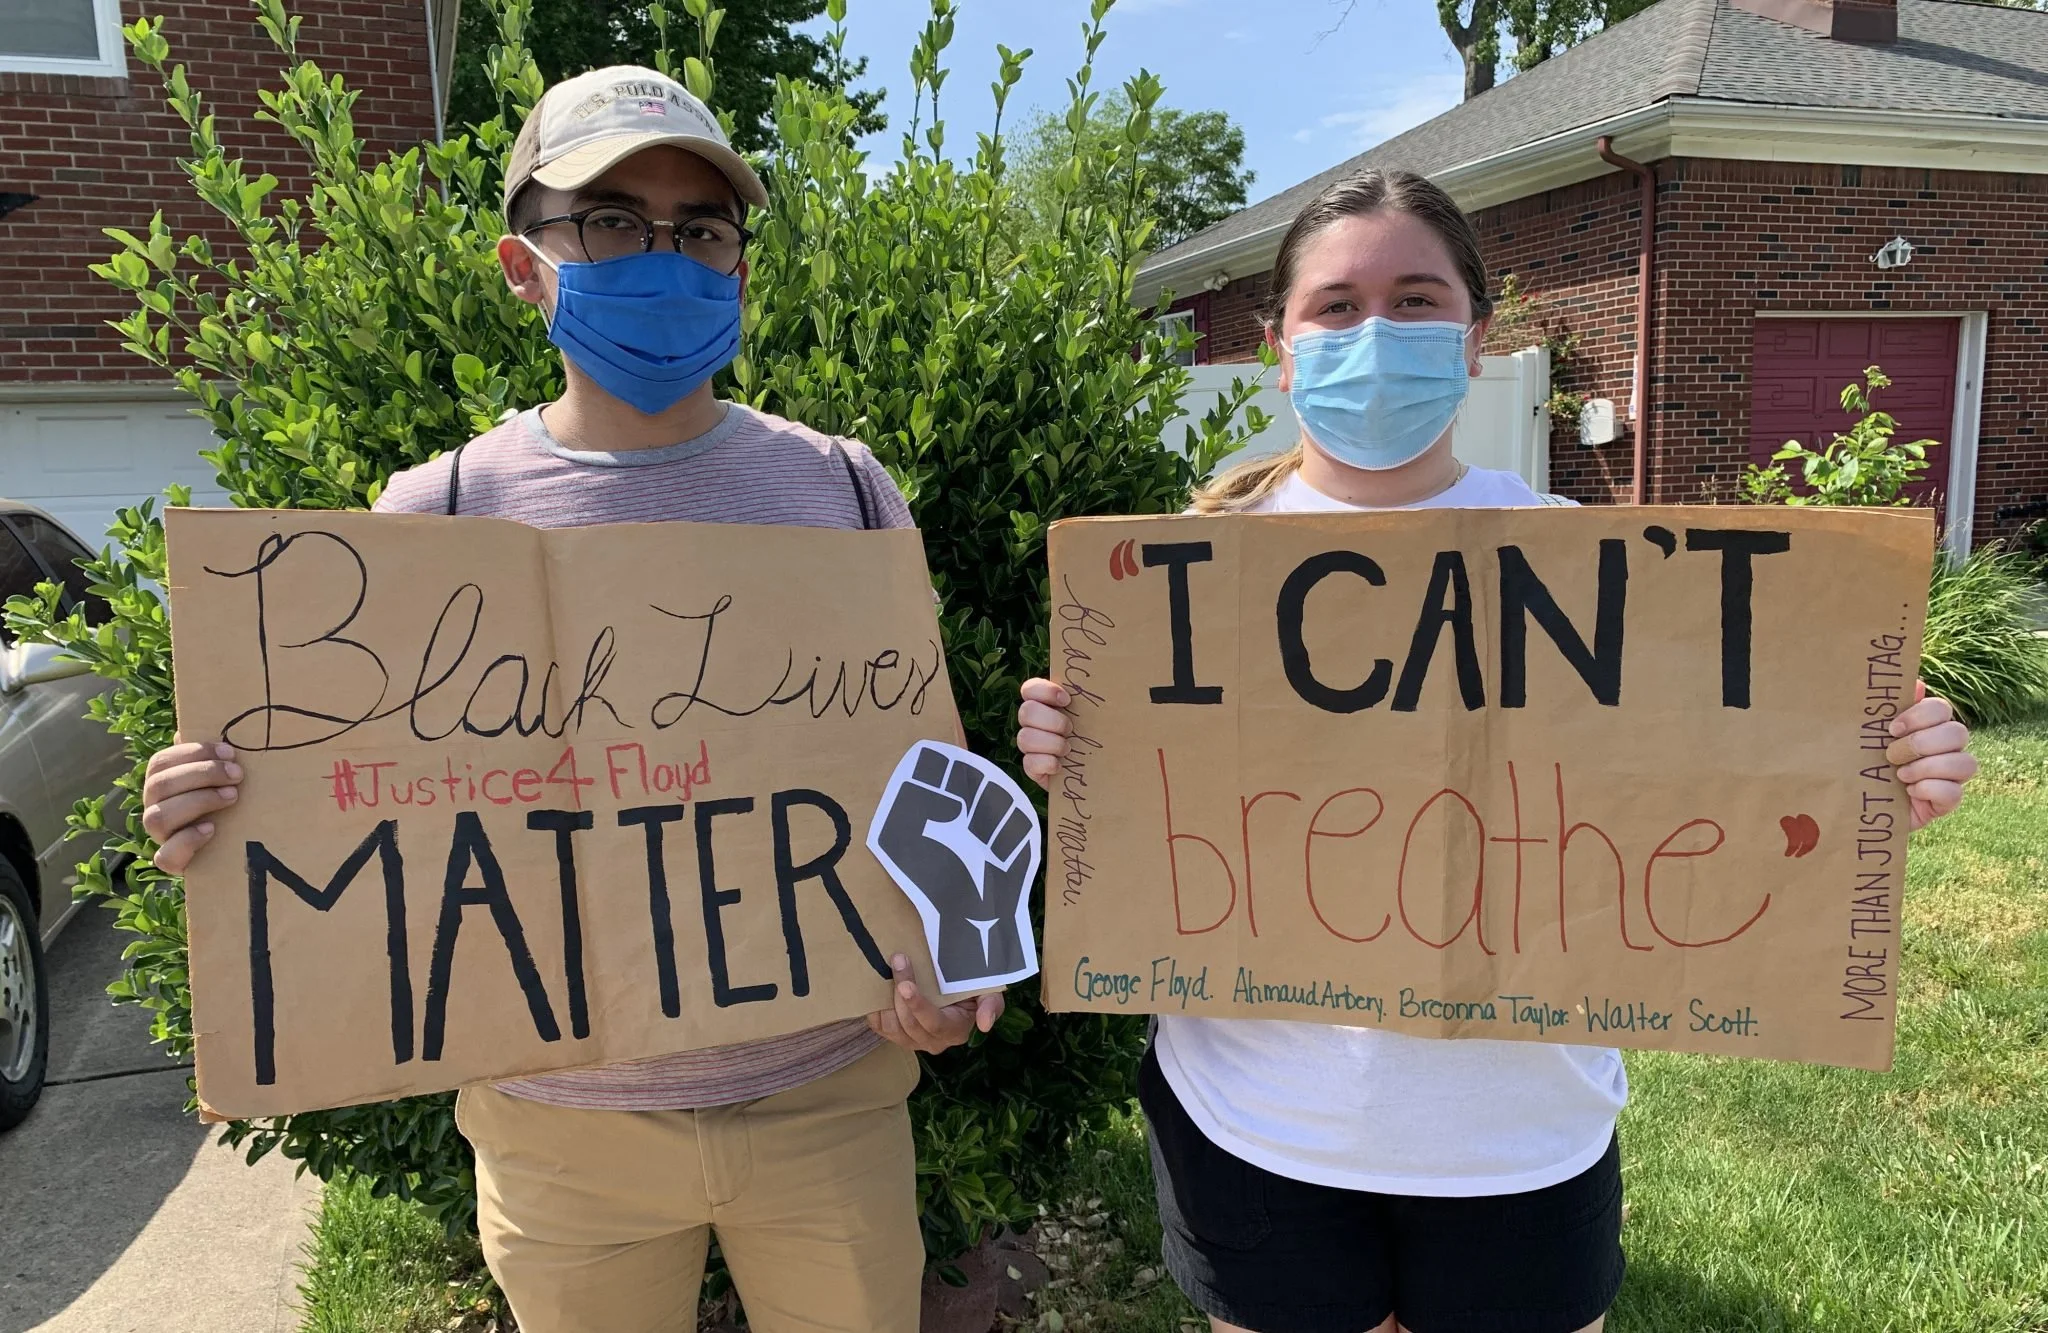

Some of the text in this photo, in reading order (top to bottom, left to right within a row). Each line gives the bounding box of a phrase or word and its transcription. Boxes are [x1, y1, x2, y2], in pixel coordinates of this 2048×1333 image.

[649, 594, 940, 729] Lives
[1859, 764, 1892, 783] A
[1857, 791, 1894, 866] JUST
[246, 788, 893, 1085] MATTER
[1851, 872, 1892, 940] THAN
[1073, 956, 1143, 1005] George
[1150, 956, 1214, 1010] Floyd.
[1399, 987, 1497, 1021] Breonna
[1584, 996, 1673, 1033] Walter
[1688, 998, 1760, 1037] Scott.
[1839, 945, 1889, 1021] MORE
